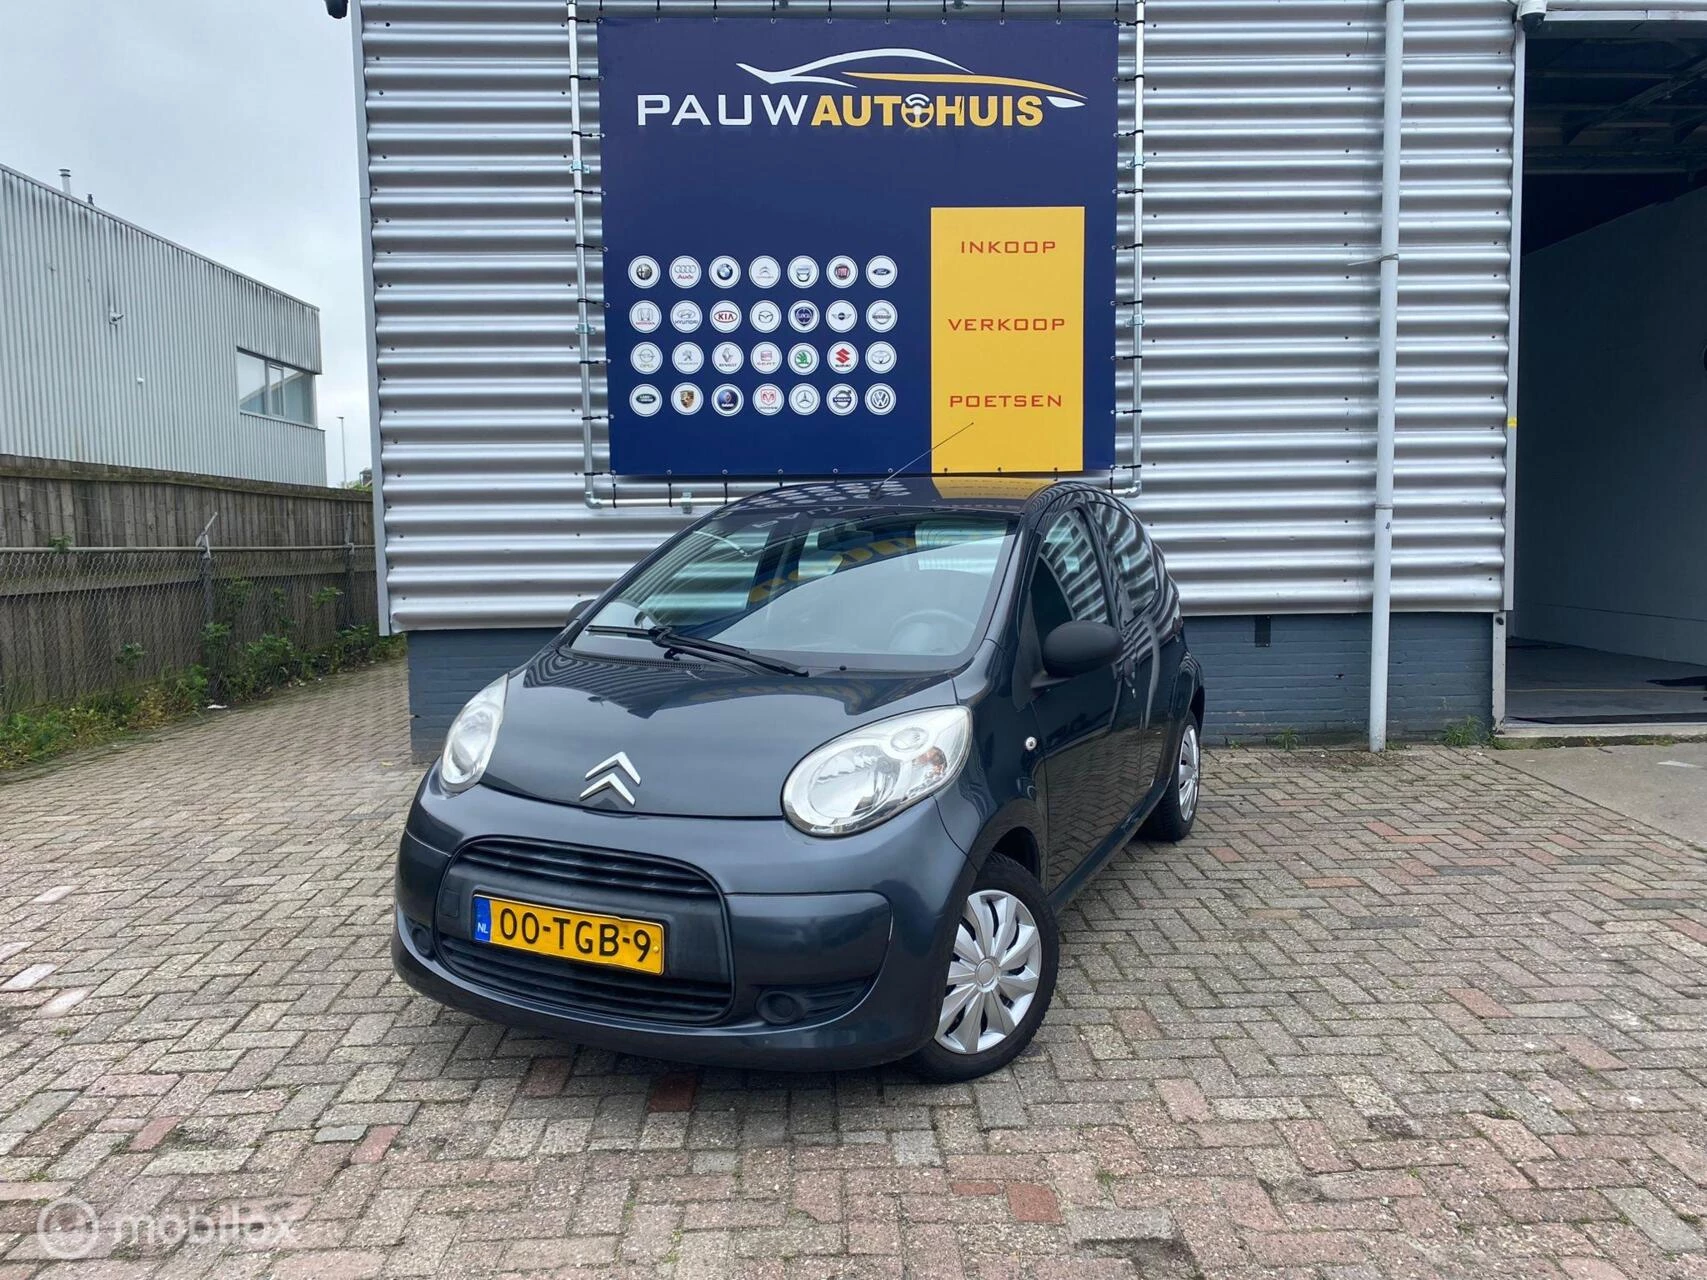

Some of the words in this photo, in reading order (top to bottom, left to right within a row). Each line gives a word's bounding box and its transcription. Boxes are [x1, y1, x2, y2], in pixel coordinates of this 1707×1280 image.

[961, 240, 1056, 254] INKOOP
[717, 313, 735, 321] KIA
[948, 318, 1065, 331] VERKOOP
[950, 395, 1062, 408] POETSEN
[477, 922, 489, 935] NL
[500, 907, 652, 963] 00-TGB-9
